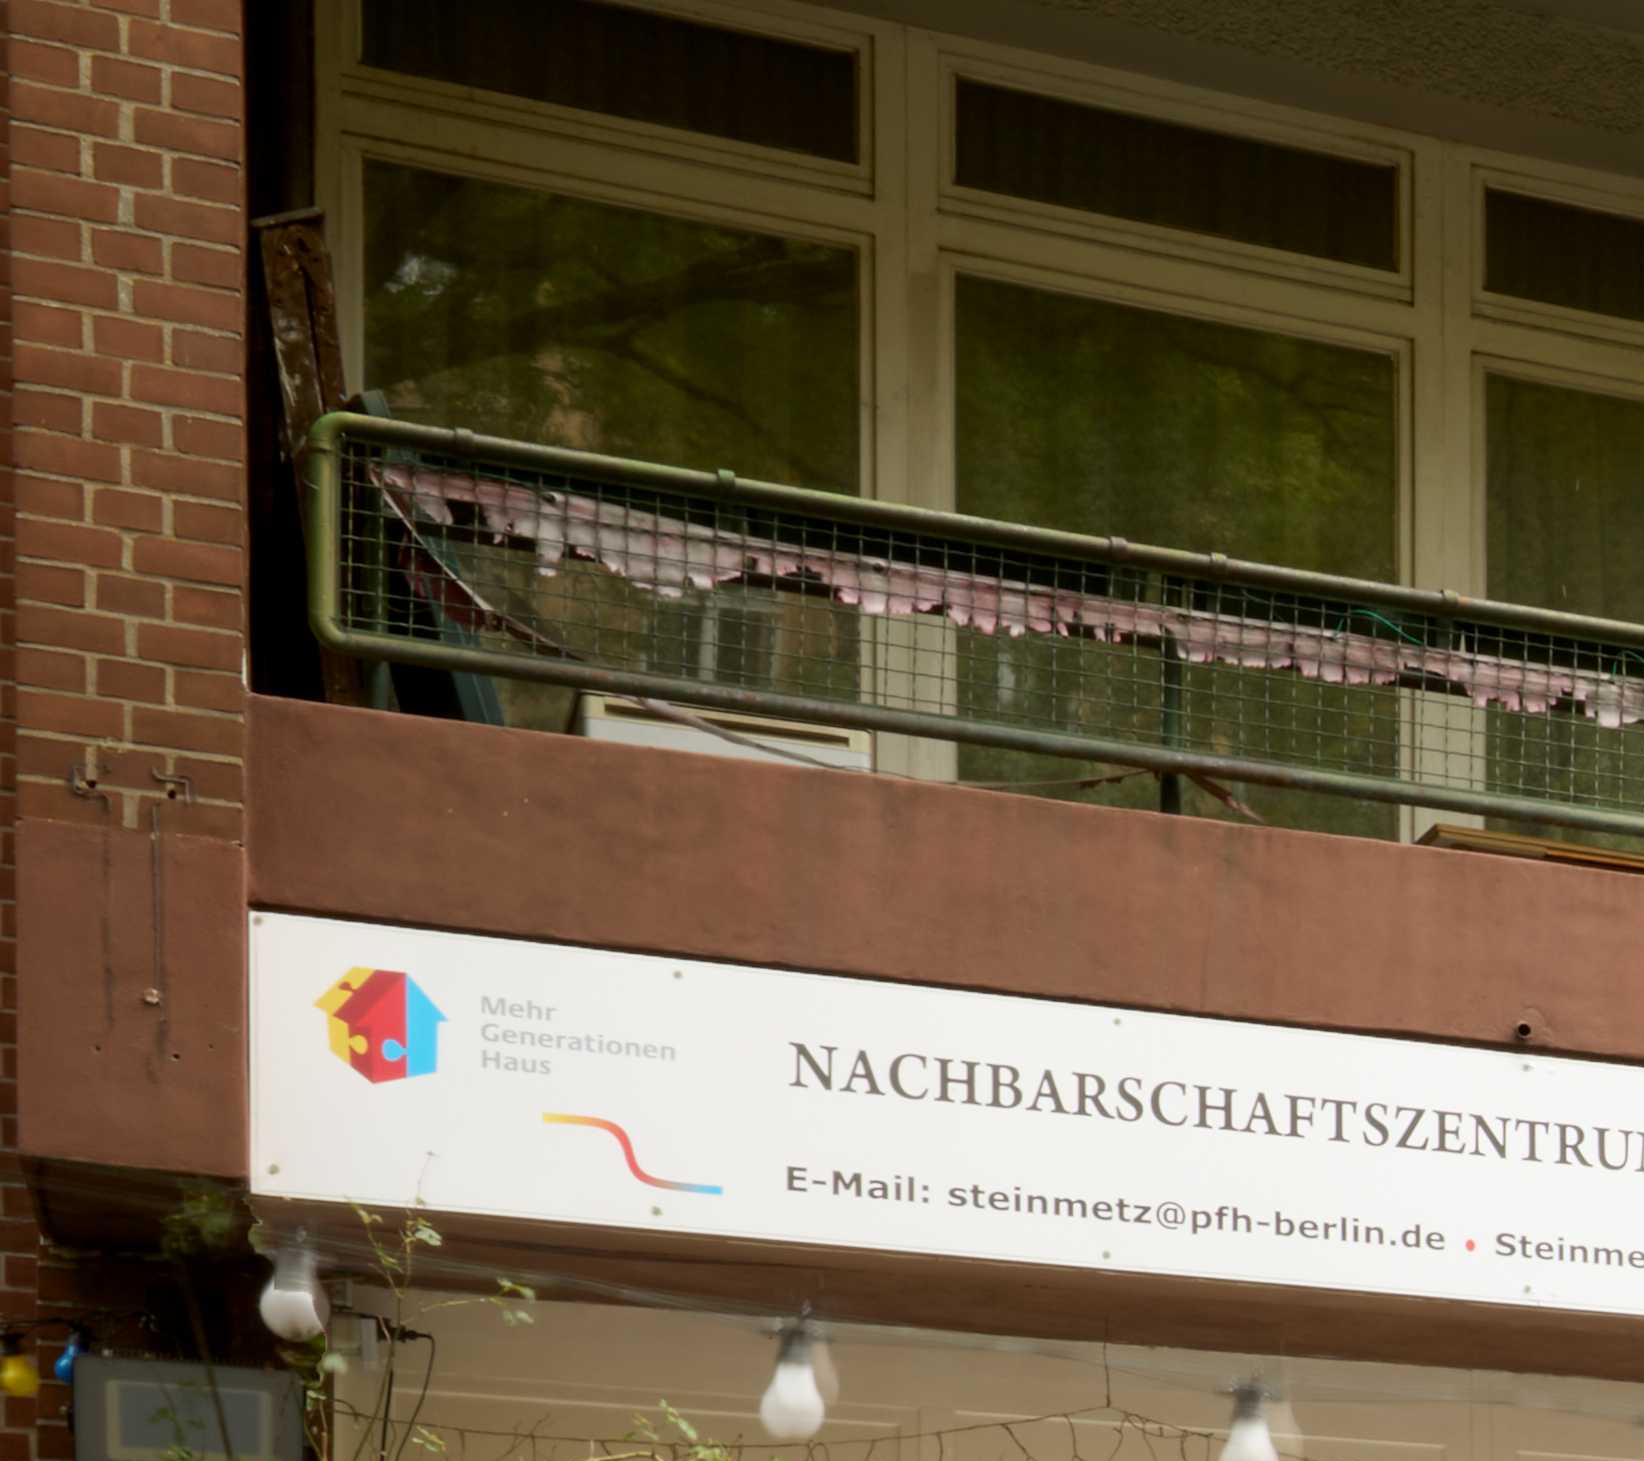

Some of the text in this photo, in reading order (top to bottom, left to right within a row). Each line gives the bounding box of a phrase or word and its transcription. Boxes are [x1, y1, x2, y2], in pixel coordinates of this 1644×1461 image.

[481, 996, 556, 1021] Mehr
[480, 1023, 677, 1061] Generationen
[480, 1049, 551, 1075] Haus
[786, 1165, 931, 1204] E-Mail:
[946, 1183, 1447, 1252] steinmetz@pfh-berlin.de
